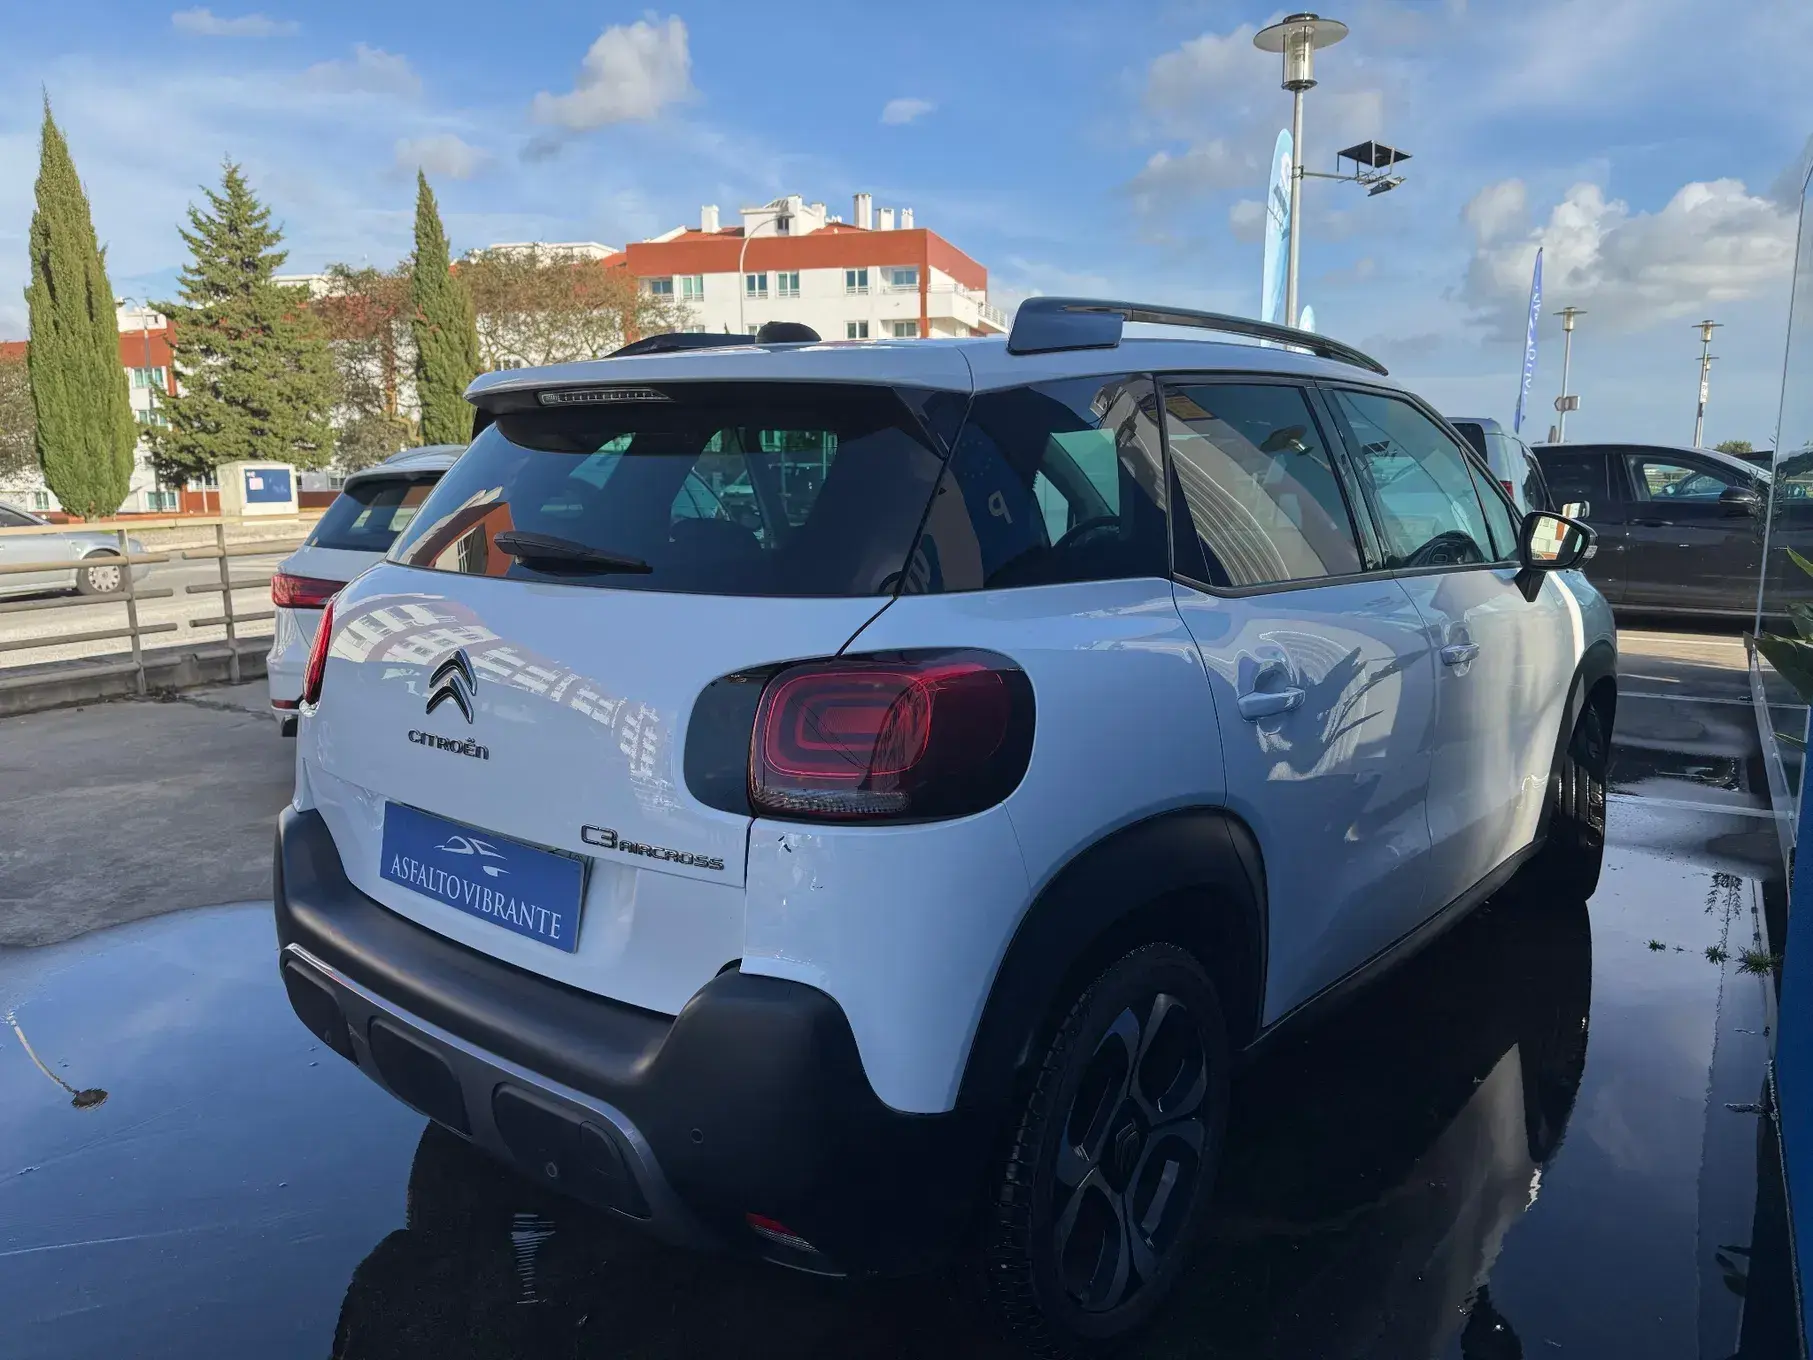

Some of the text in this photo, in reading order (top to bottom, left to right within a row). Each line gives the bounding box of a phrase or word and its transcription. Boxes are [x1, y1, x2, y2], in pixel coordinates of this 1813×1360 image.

[580, 824, 725, 871] C3 AIRCROSS
[390, 854, 562, 940] ASFALTOVIBRANTE
